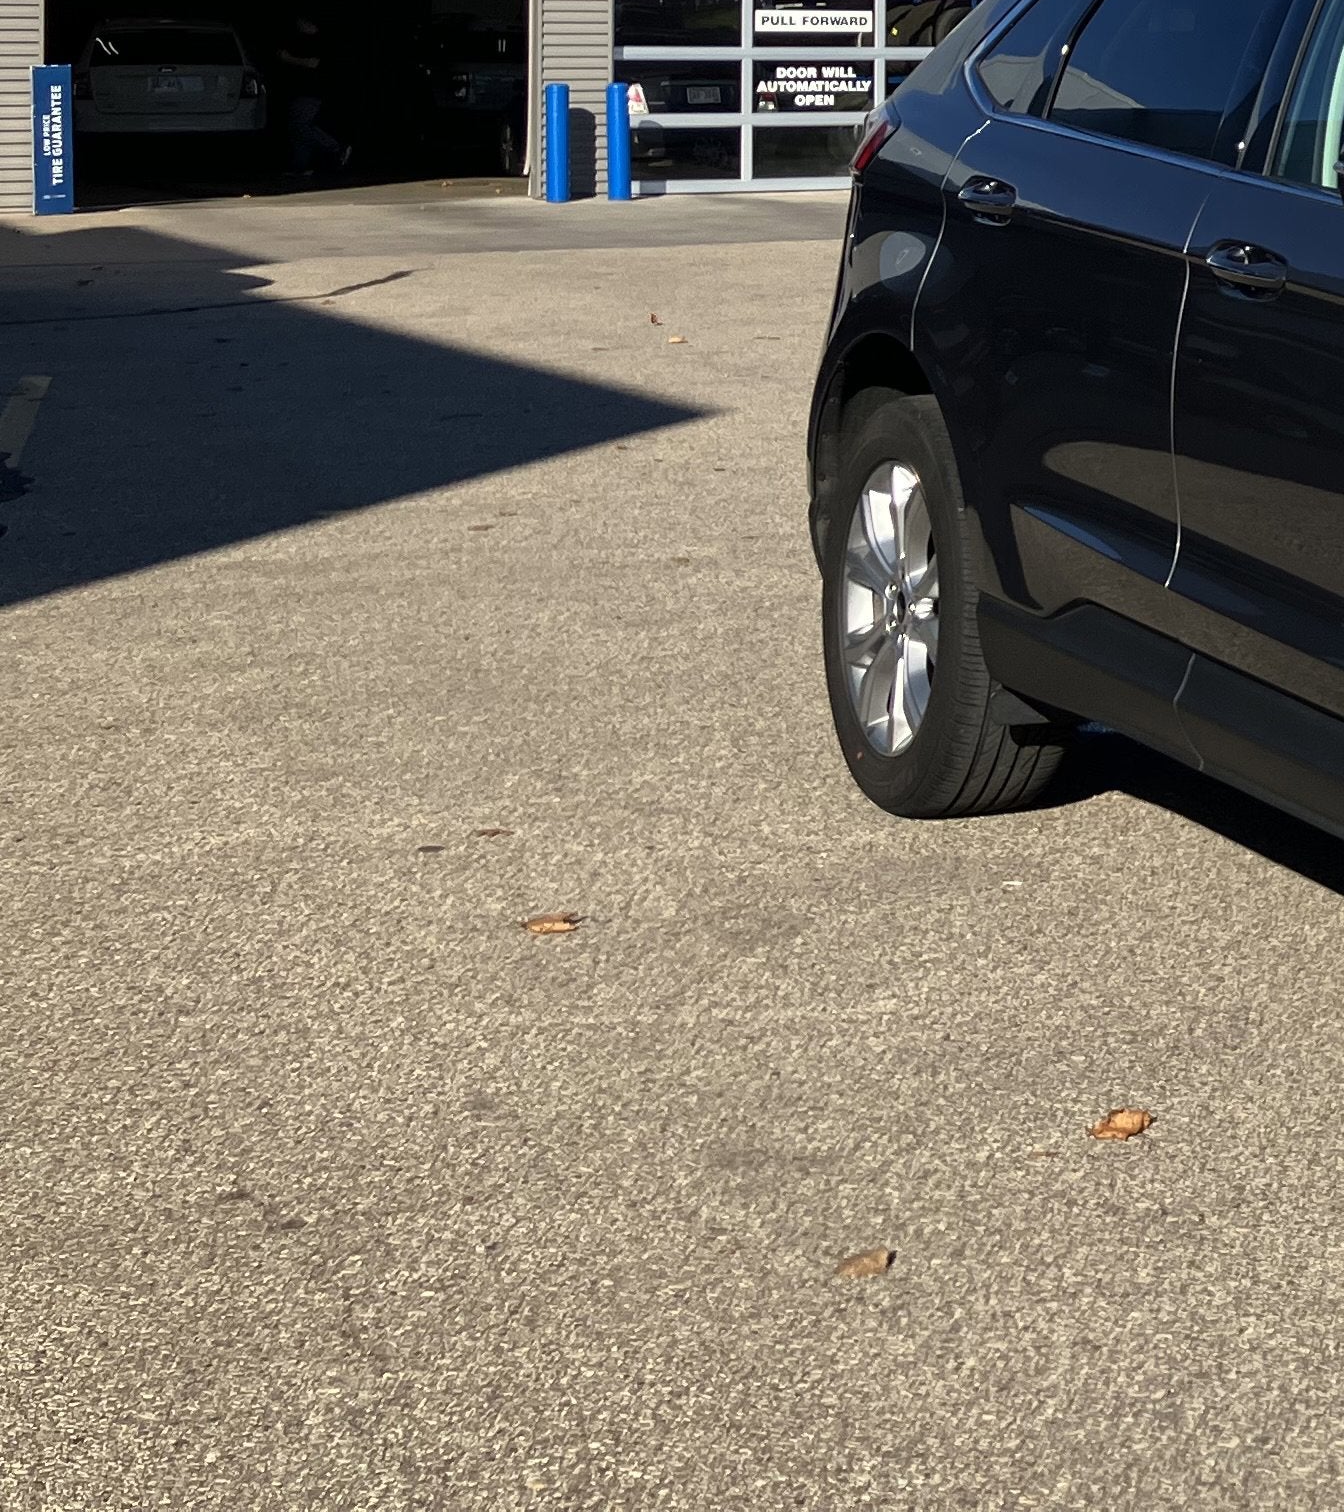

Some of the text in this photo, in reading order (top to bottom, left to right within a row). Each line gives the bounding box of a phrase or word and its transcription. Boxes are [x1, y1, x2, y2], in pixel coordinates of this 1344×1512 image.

[761, 15, 868, 27] PULL FORWARD
[776, 67, 857, 79] DOOR WILL
[756, 80, 872, 93] AUTOMATICALLY
[794, 94, 835, 106] OPEN
[50, 85, 63, 157] GUARANTEE
[42, 114, 51, 156] LOW PRICE
[52, 158, 64, 186] TIRE
